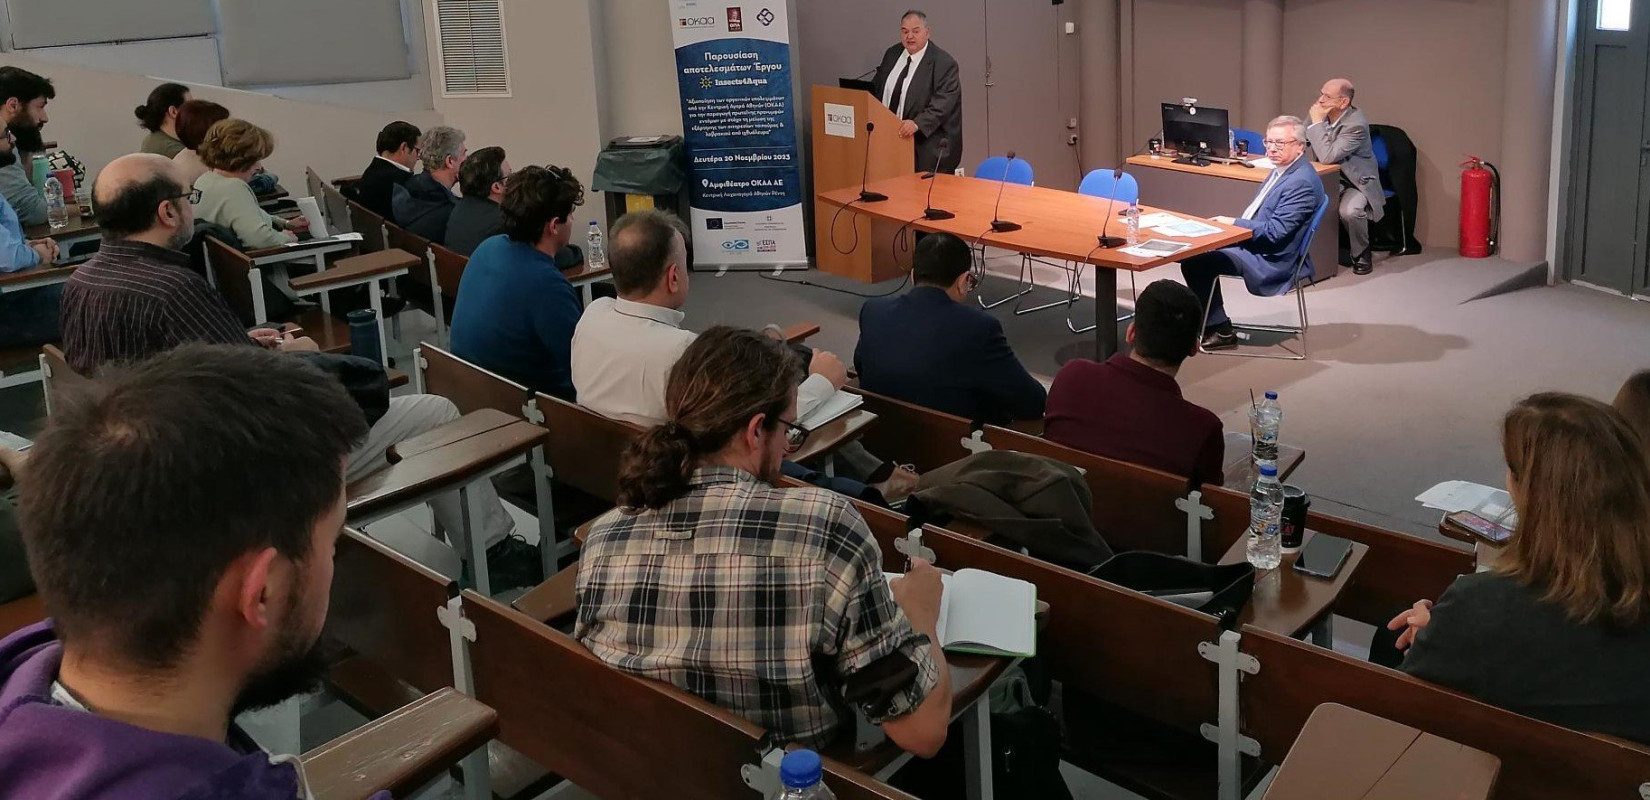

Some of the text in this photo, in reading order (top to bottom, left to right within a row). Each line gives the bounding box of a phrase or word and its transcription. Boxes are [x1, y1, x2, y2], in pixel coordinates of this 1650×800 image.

[704, 51, 759, 61] Παρουσίαση
[683, 62, 782, 74] αποτελεσμάτων Έργου
[715, 77, 768, 86] Insects4Aqua
[693, 155, 723, 163] Δευτέρα
[735, 153, 772, 162] Νοεμβρίου
[708, 180, 750, 189] Αμφιθέατρο
